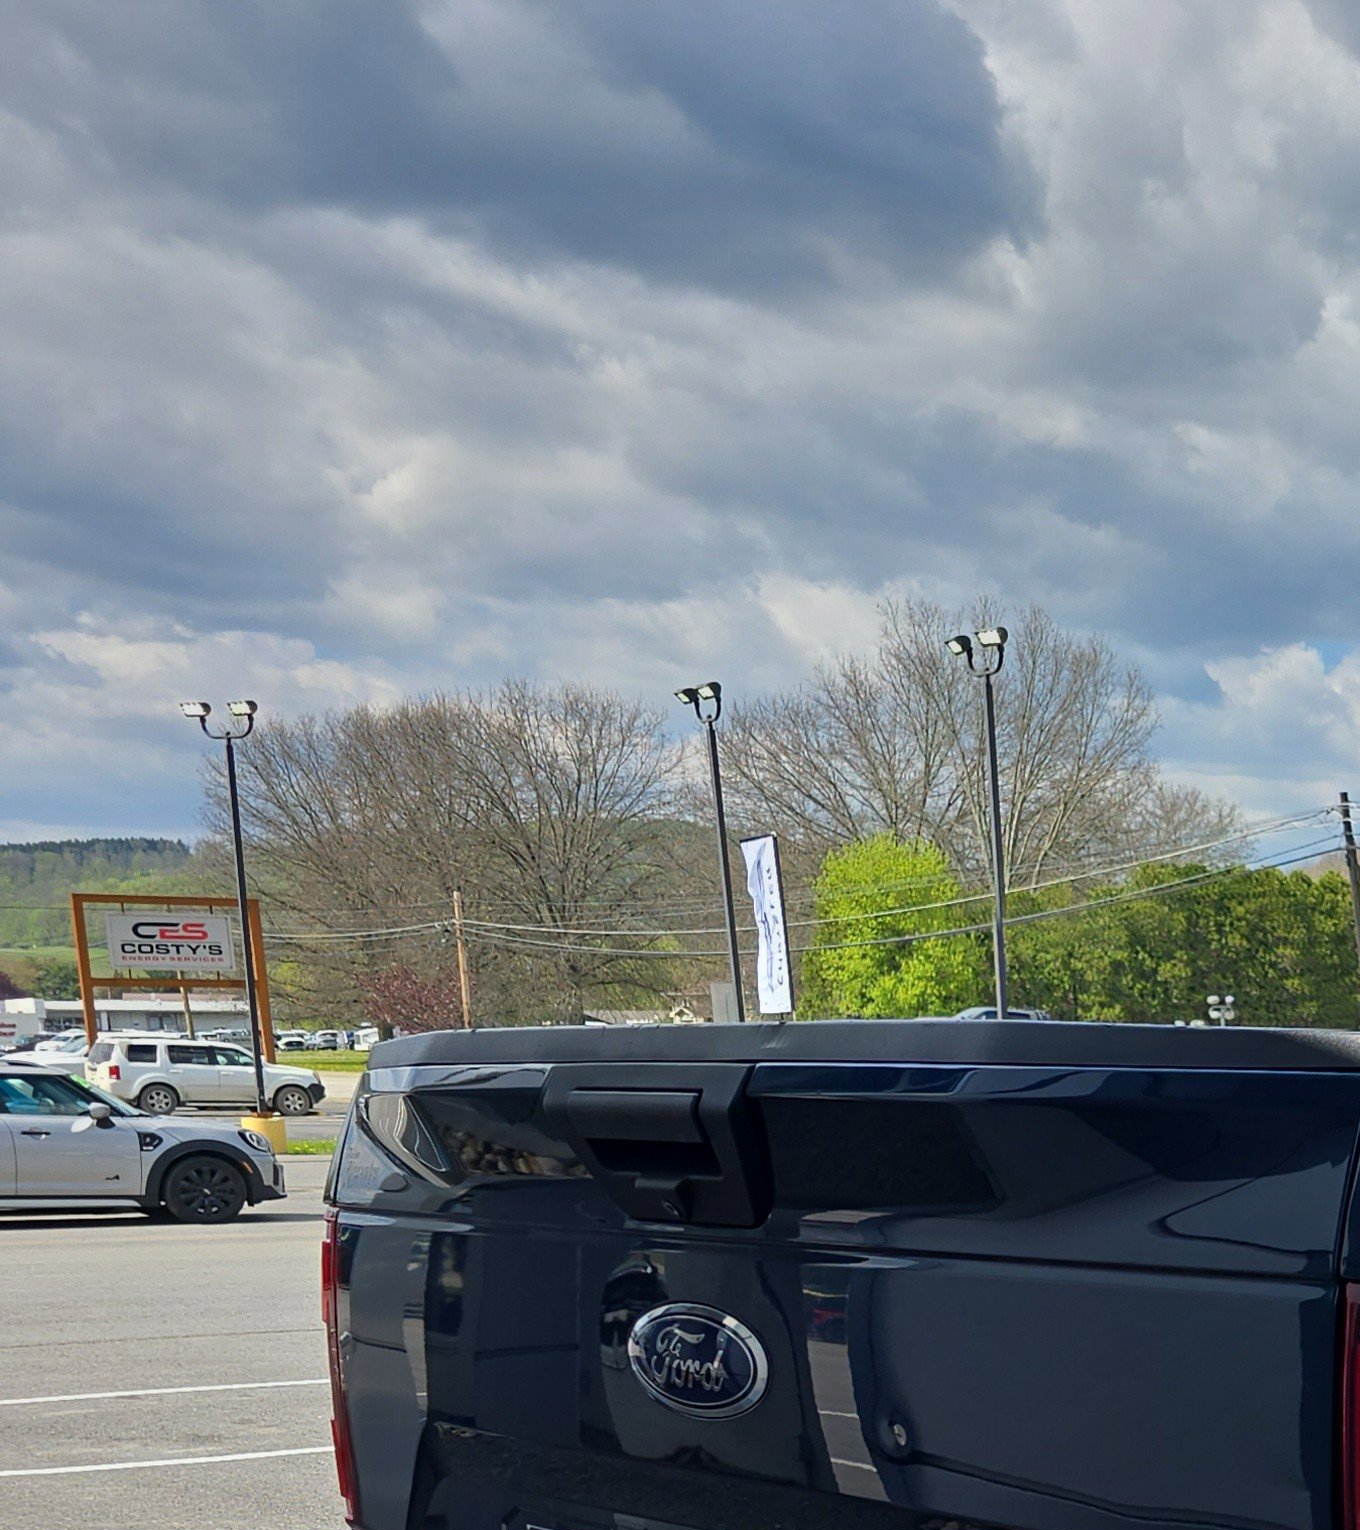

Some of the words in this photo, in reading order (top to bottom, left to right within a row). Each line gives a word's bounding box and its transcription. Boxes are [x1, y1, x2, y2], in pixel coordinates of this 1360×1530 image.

[132, 922, 208, 940] CES
[121, 943, 223, 956] COSTY'S
[650, 1322, 730, 1392] Ford
